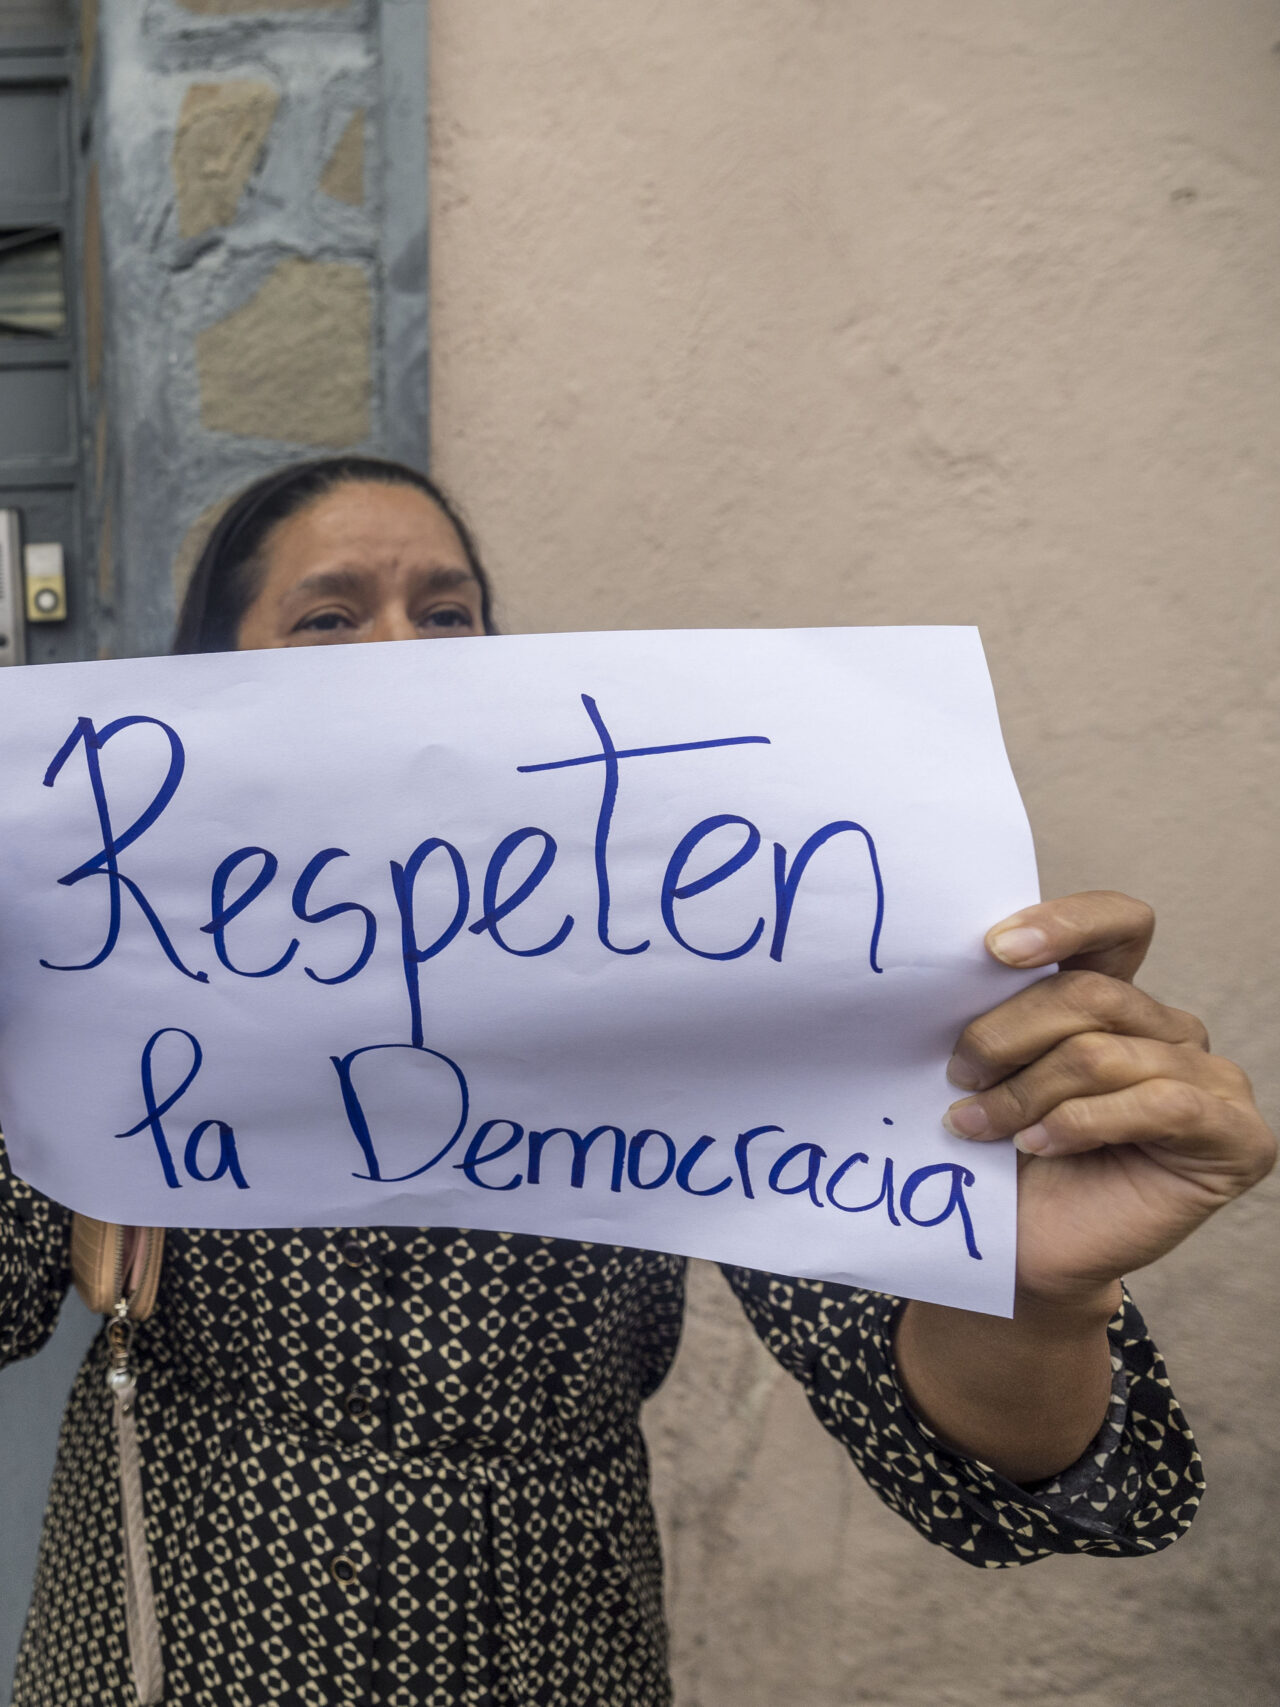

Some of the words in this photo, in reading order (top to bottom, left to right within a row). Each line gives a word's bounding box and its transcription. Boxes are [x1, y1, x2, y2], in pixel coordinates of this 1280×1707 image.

[39, 693, 886, 1047] Respeten
[115, 1027, 250, 1191] la
[330, 1043, 984, 1262] Democracia
